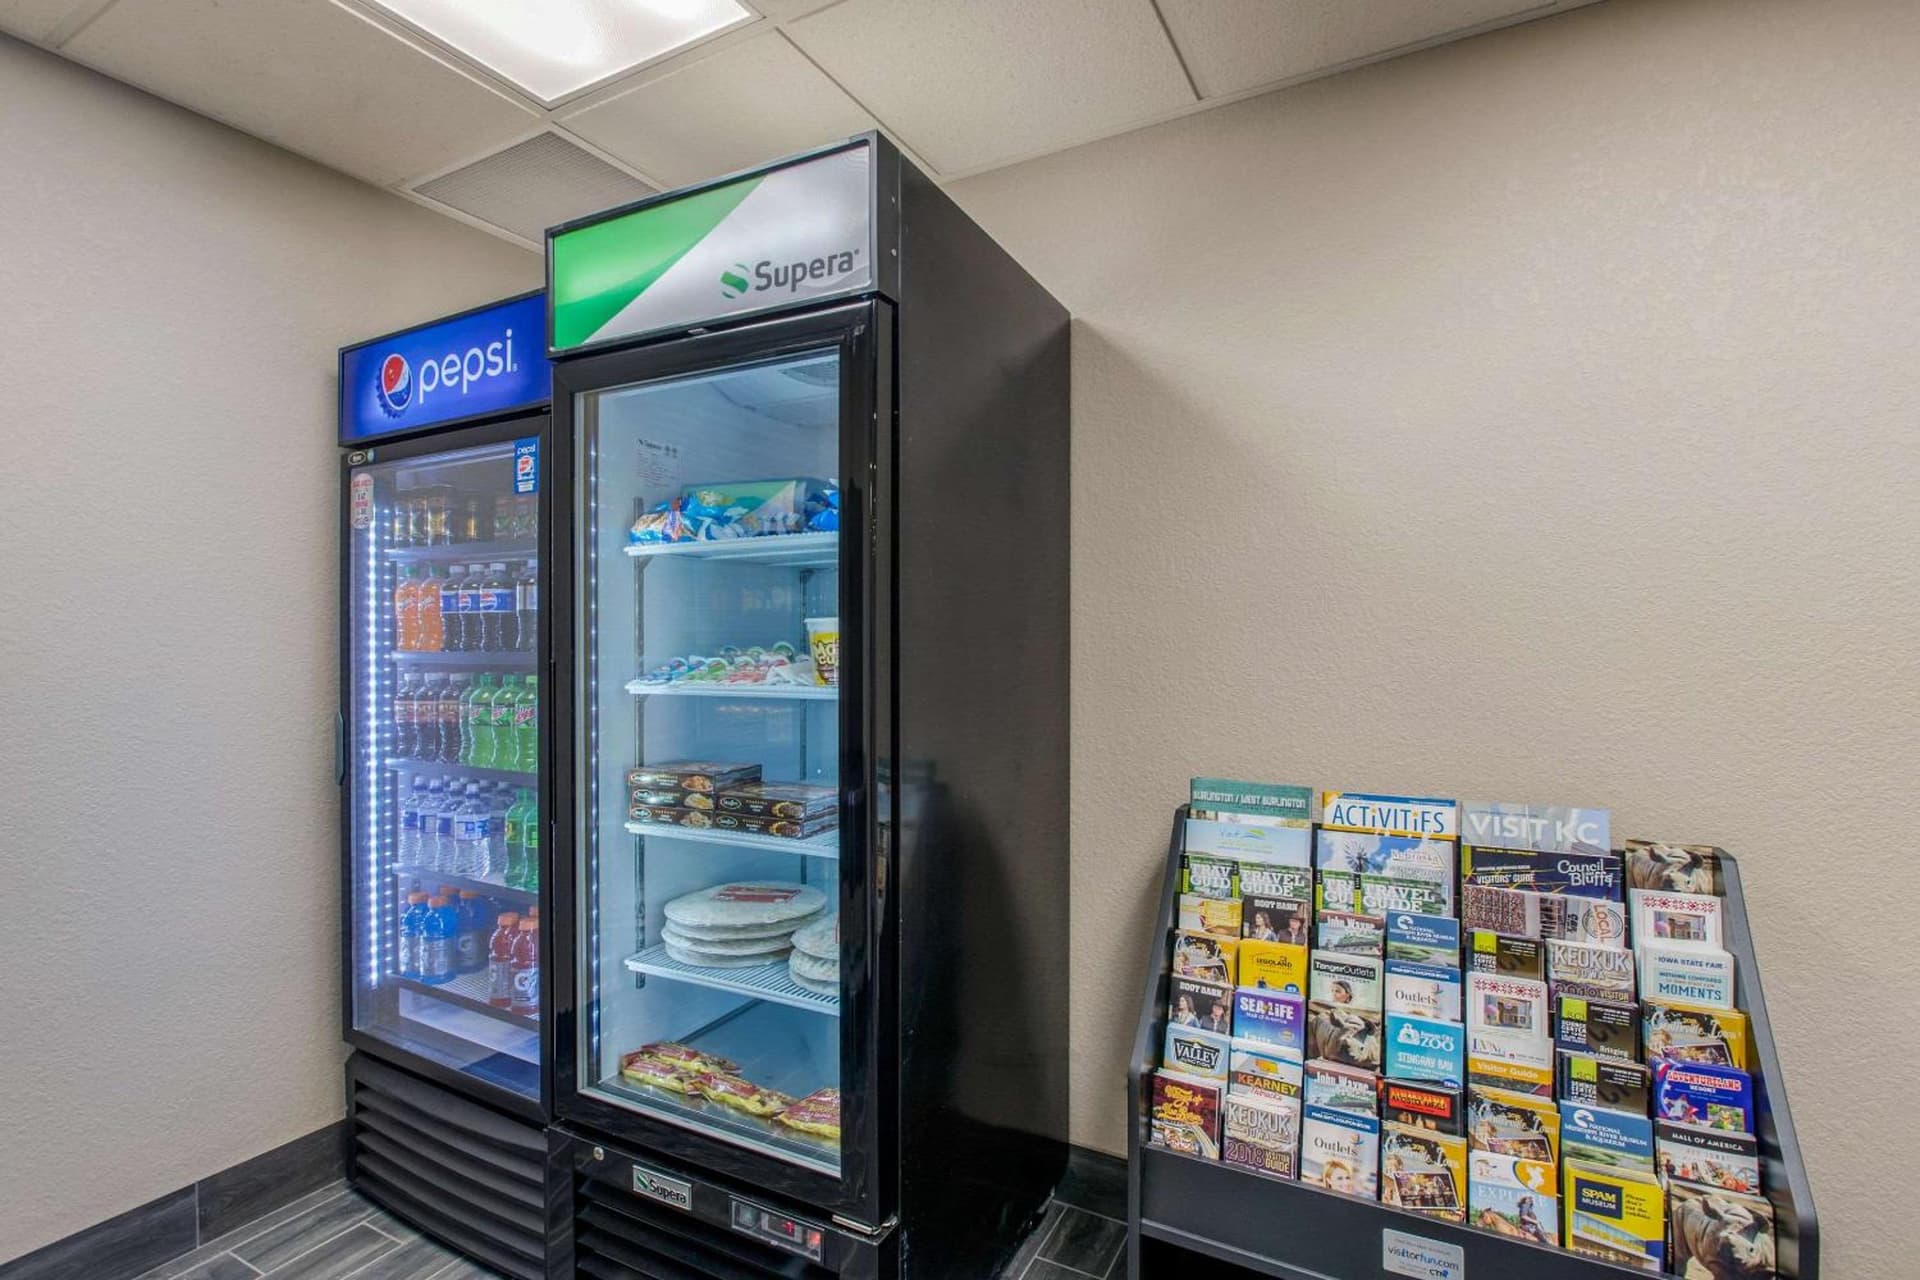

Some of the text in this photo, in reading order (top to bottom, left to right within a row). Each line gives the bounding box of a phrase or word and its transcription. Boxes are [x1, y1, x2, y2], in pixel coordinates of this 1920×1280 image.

[755, 250, 854, 292] Supera
[419, 328, 513, 404] pepsi
[1263, 796, 1305, 809] BURLINGTON
[1470, 813, 1600, 845] VISIT KC
[1557, 858, 1604, 874] Council
[1240, 869, 1305, 887] TRAVEL
[1569, 872, 1613, 888] Bluffs
[1240, 880, 1294, 897] GUIDE
[1363, 884, 1435, 903] TRAVEL
[1254, 899, 1274, 910] BOOT
[1362, 895, 1423, 913] GUIDE
[1593, 903, 1612, 941] LOCAL
[1256, 956, 1293, 969] LEGOLAND
[1554, 944, 1630, 973] KEOKUK
[1658, 956, 1724, 970] IOWA STATE FAIR
[1315, 960, 1375, 978] TangerOutlets
[1180, 981, 1200, 993] BOOT
[1659, 982, 1722, 1001] MOMENTS
[1240, 996, 1264, 1013] SEA
[1395, 990, 1438, 1005] Outlets
[1420, 1036, 1455, 1052] ZOO
[1175, 1041, 1219, 1067] VALLEY
[1477, 1061, 1539, 1080] Visitor Guide
[1238, 1072, 1298, 1095] KEARNEY
[1314, 1071, 1370, 1092] John Wayne
[1667, 1070, 1742, 1091] ADVENTURELAND
[1226, 1102, 1290, 1136] KEOKUK
[1589, 1124, 1621, 1135] NATIONAL
[1600, 1131, 1618, 1141] RIVER
[1619, 1135, 1648, 1146] MUSEUM
[1314, 1135, 1358, 1157] Outlets
[1672, 1133, 1744, 1151] MALL OF AMERICA
[1225, 1141, 1265, 1168] 2018
[1265, 1159, 1291, 1174] GUIDE
[649, 1178, 688, 1206] Supera
[1581, 1187, 1617, 1203] SPAM
[1581, 1197, 1617, 1210] MUSEUM
